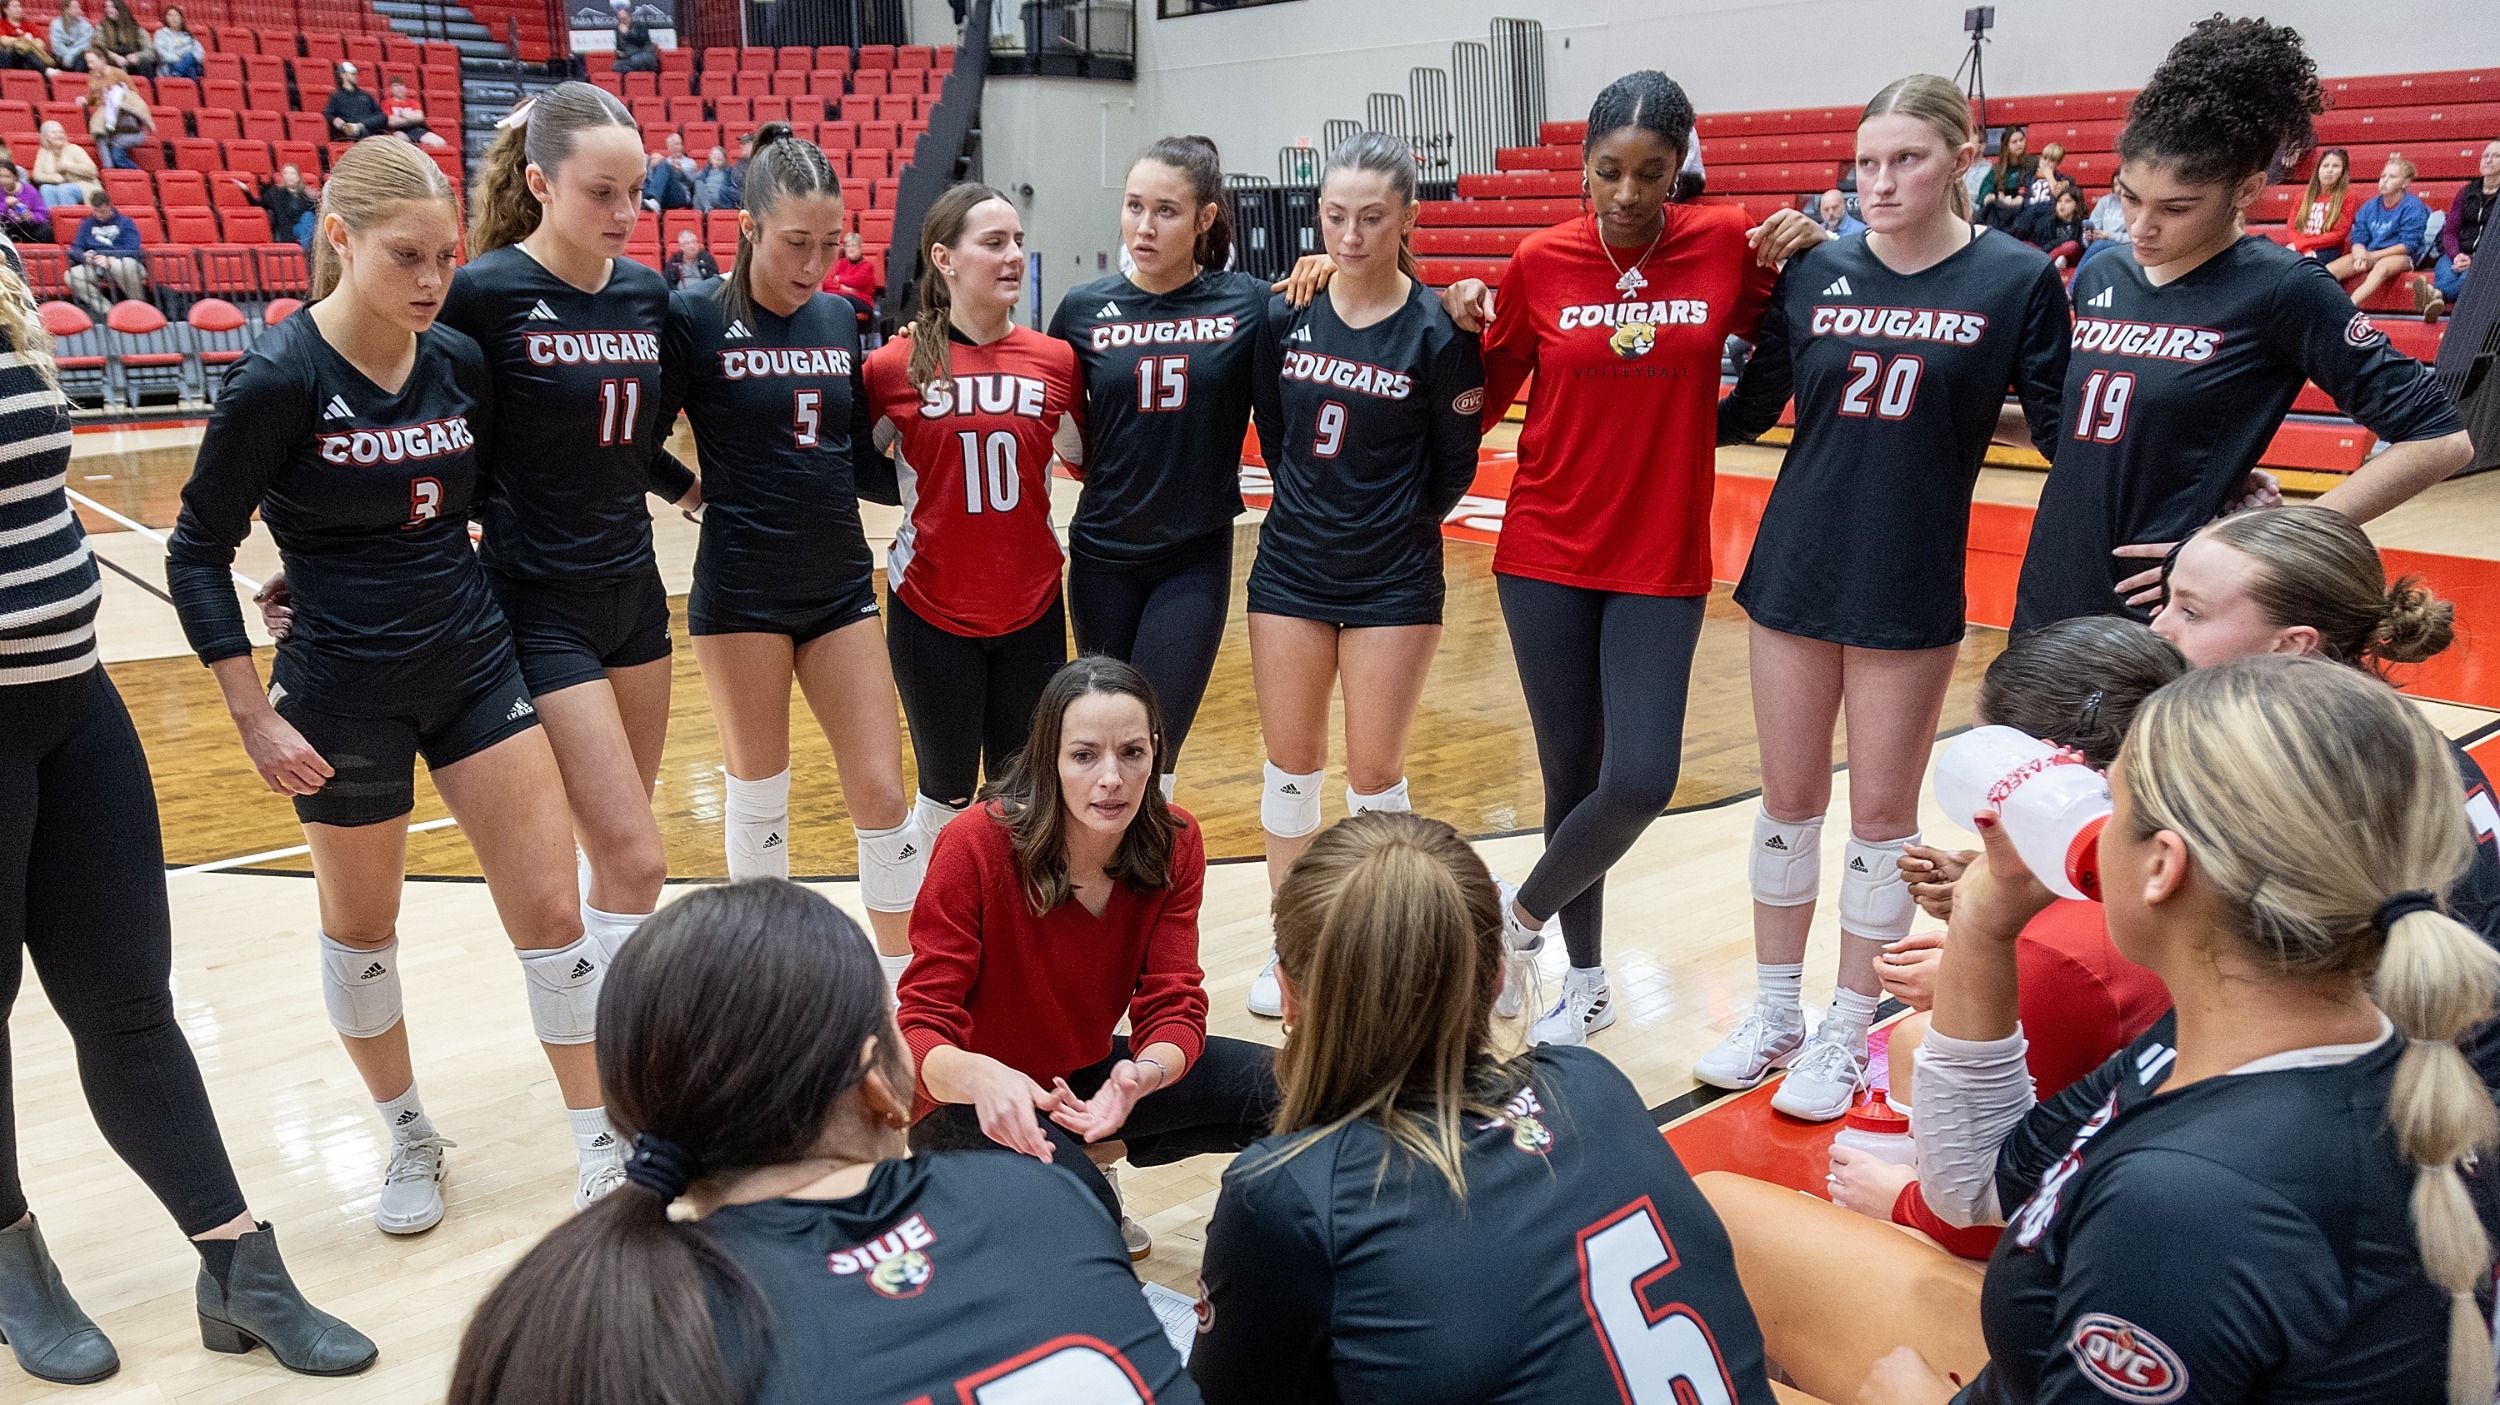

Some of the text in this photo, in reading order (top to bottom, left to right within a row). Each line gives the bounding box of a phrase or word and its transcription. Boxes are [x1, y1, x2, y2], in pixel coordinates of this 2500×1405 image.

[1091, 315, 1238, 351] COUGARS
[1559, 300, 1709, 331] COUGARS
[1813, 305, 1988, 346] COUGARS
[526, 332, 659, 364] COUGARS
[2071, 318, 2224, 362] COUGARS
[719, 348, 851, 380] COUGARS
[1136, 355, 1188, 412] 15
[1281, 350, 1413, 399] COUGARS
[1573, 367, 1688, 379] VOLLEYBALL
[1839, 352, 1924, 420] 20
[600, 378, 640, 446] 11
[795, 389, 821, 448] 5
[920, 373, 1046, 419] SIUE
[2075, 370, 2136, 444] 19
[318, 417, 474, 465] COUGARS
[1314, 401, 1347, 458] 9
[956, 430, 1021, 514] 10
[403, 478, 444, 530] 3
[763, 838, 783, 849] adidas
[1765, 841, 1788, 850] adidas
[1850, 863, 1869, 873] adidas
[361, 968, 386, 980] adidas
[571, 964, 594, 979] adidas
[396, 1112, 419, 1126] adidas
[592, 1137, 615, 1148] adidas
[828, 1212, 937, 1275] SIUE
[1575, 1195, 1739, 1405] 6
[2086, 1333, 2158, 1385] OVC
